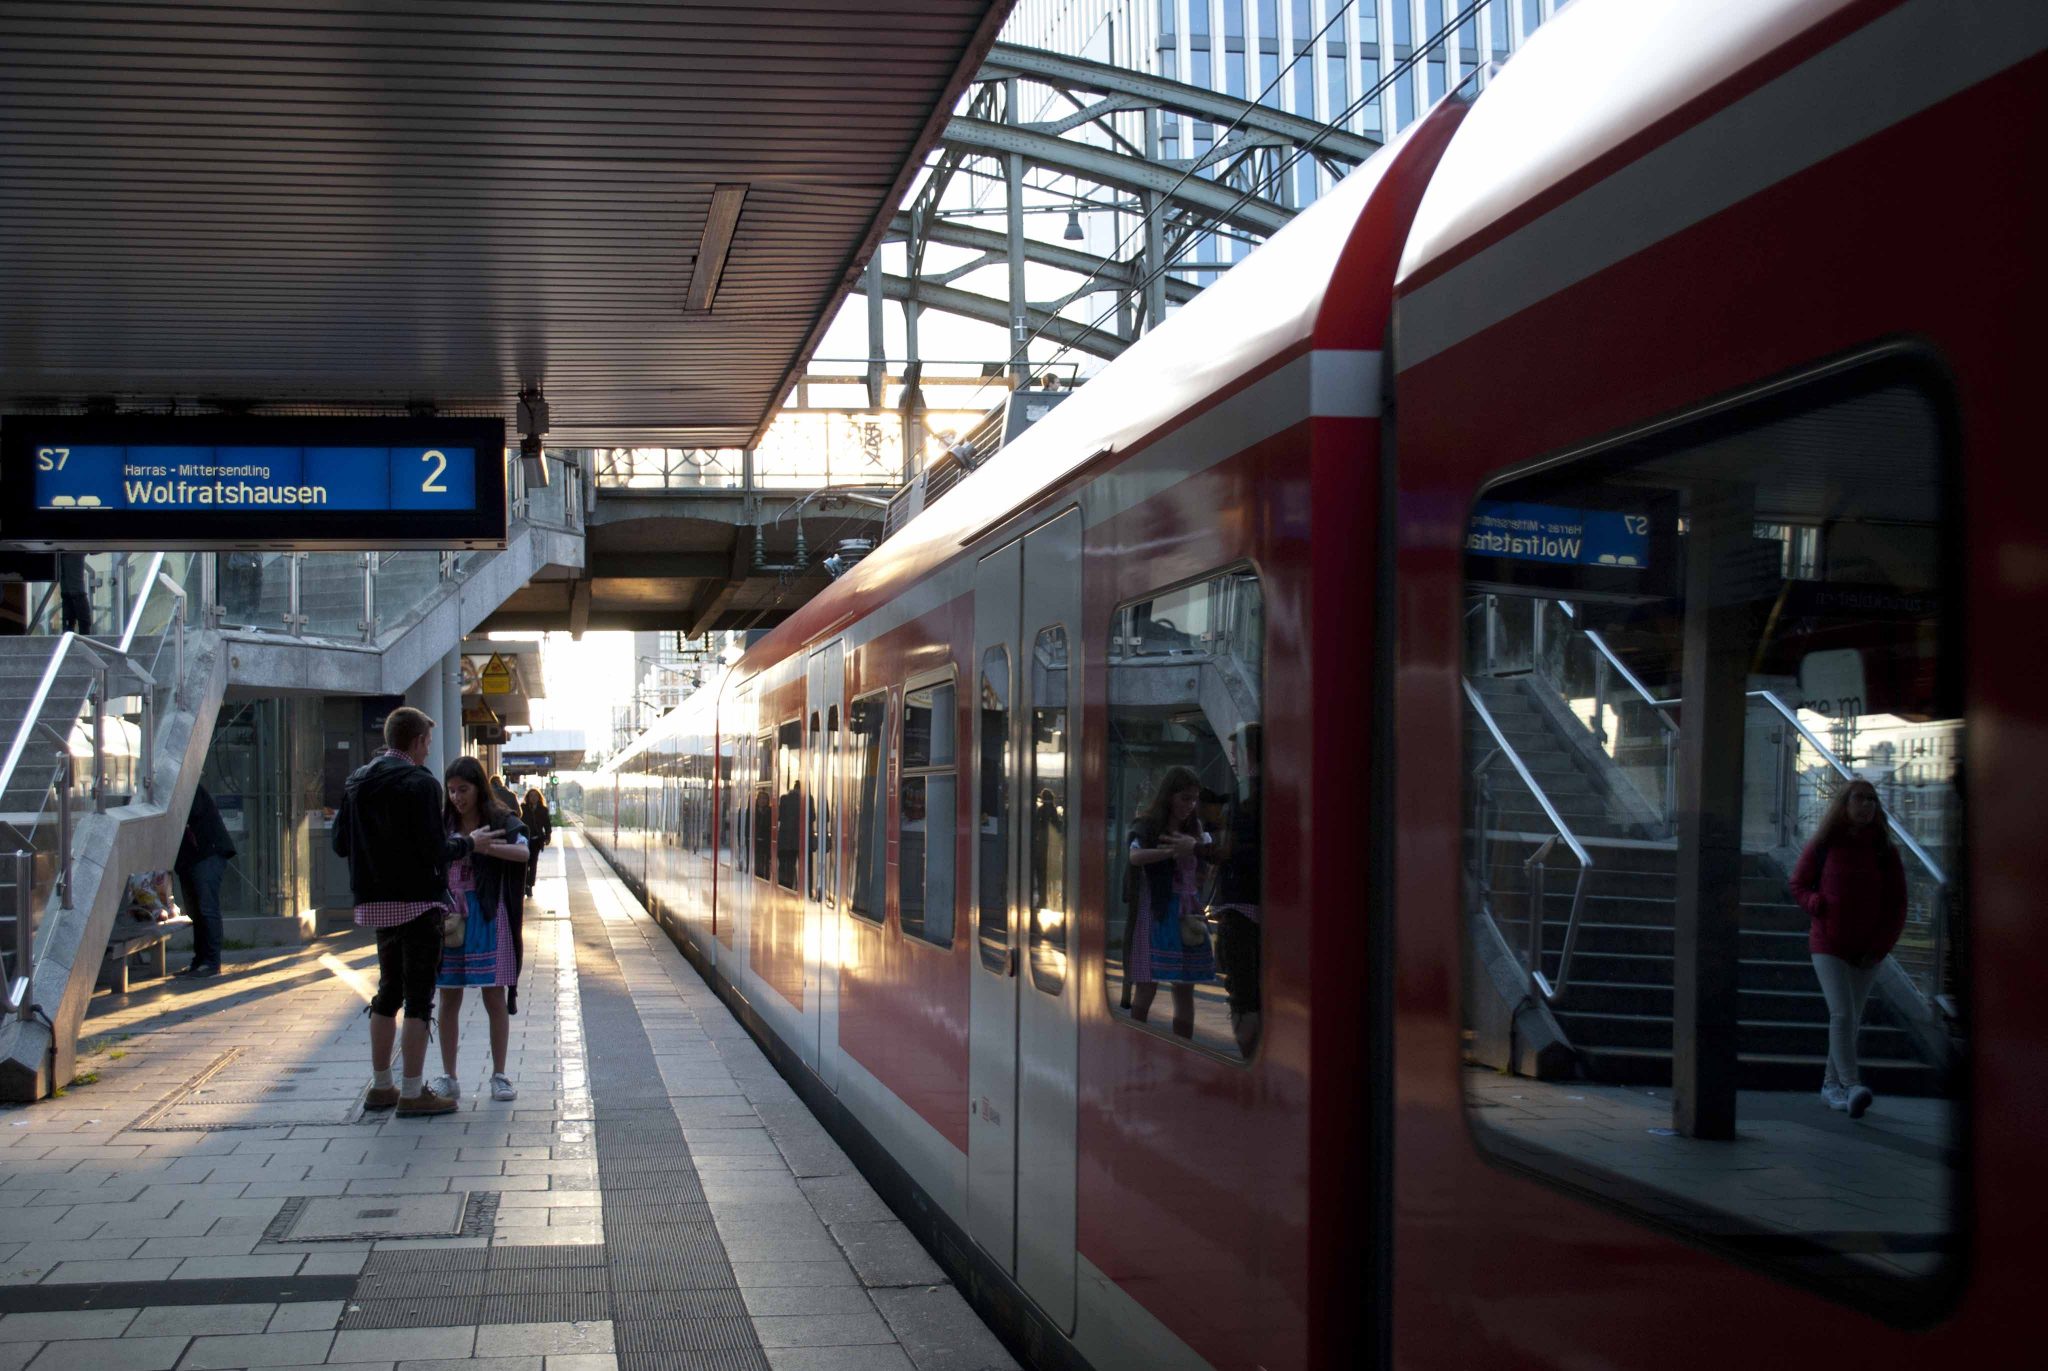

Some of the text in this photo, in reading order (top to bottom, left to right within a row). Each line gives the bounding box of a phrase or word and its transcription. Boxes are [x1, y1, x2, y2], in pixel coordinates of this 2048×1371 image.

[39, 448, 70, 471] S7
[125, 464, 168, 476] Harras
[179, 464, 271, 480] Mittersendling
[421, 450, 447, 493] 2
[125, 480, 327, 504] Wolfratshausen
